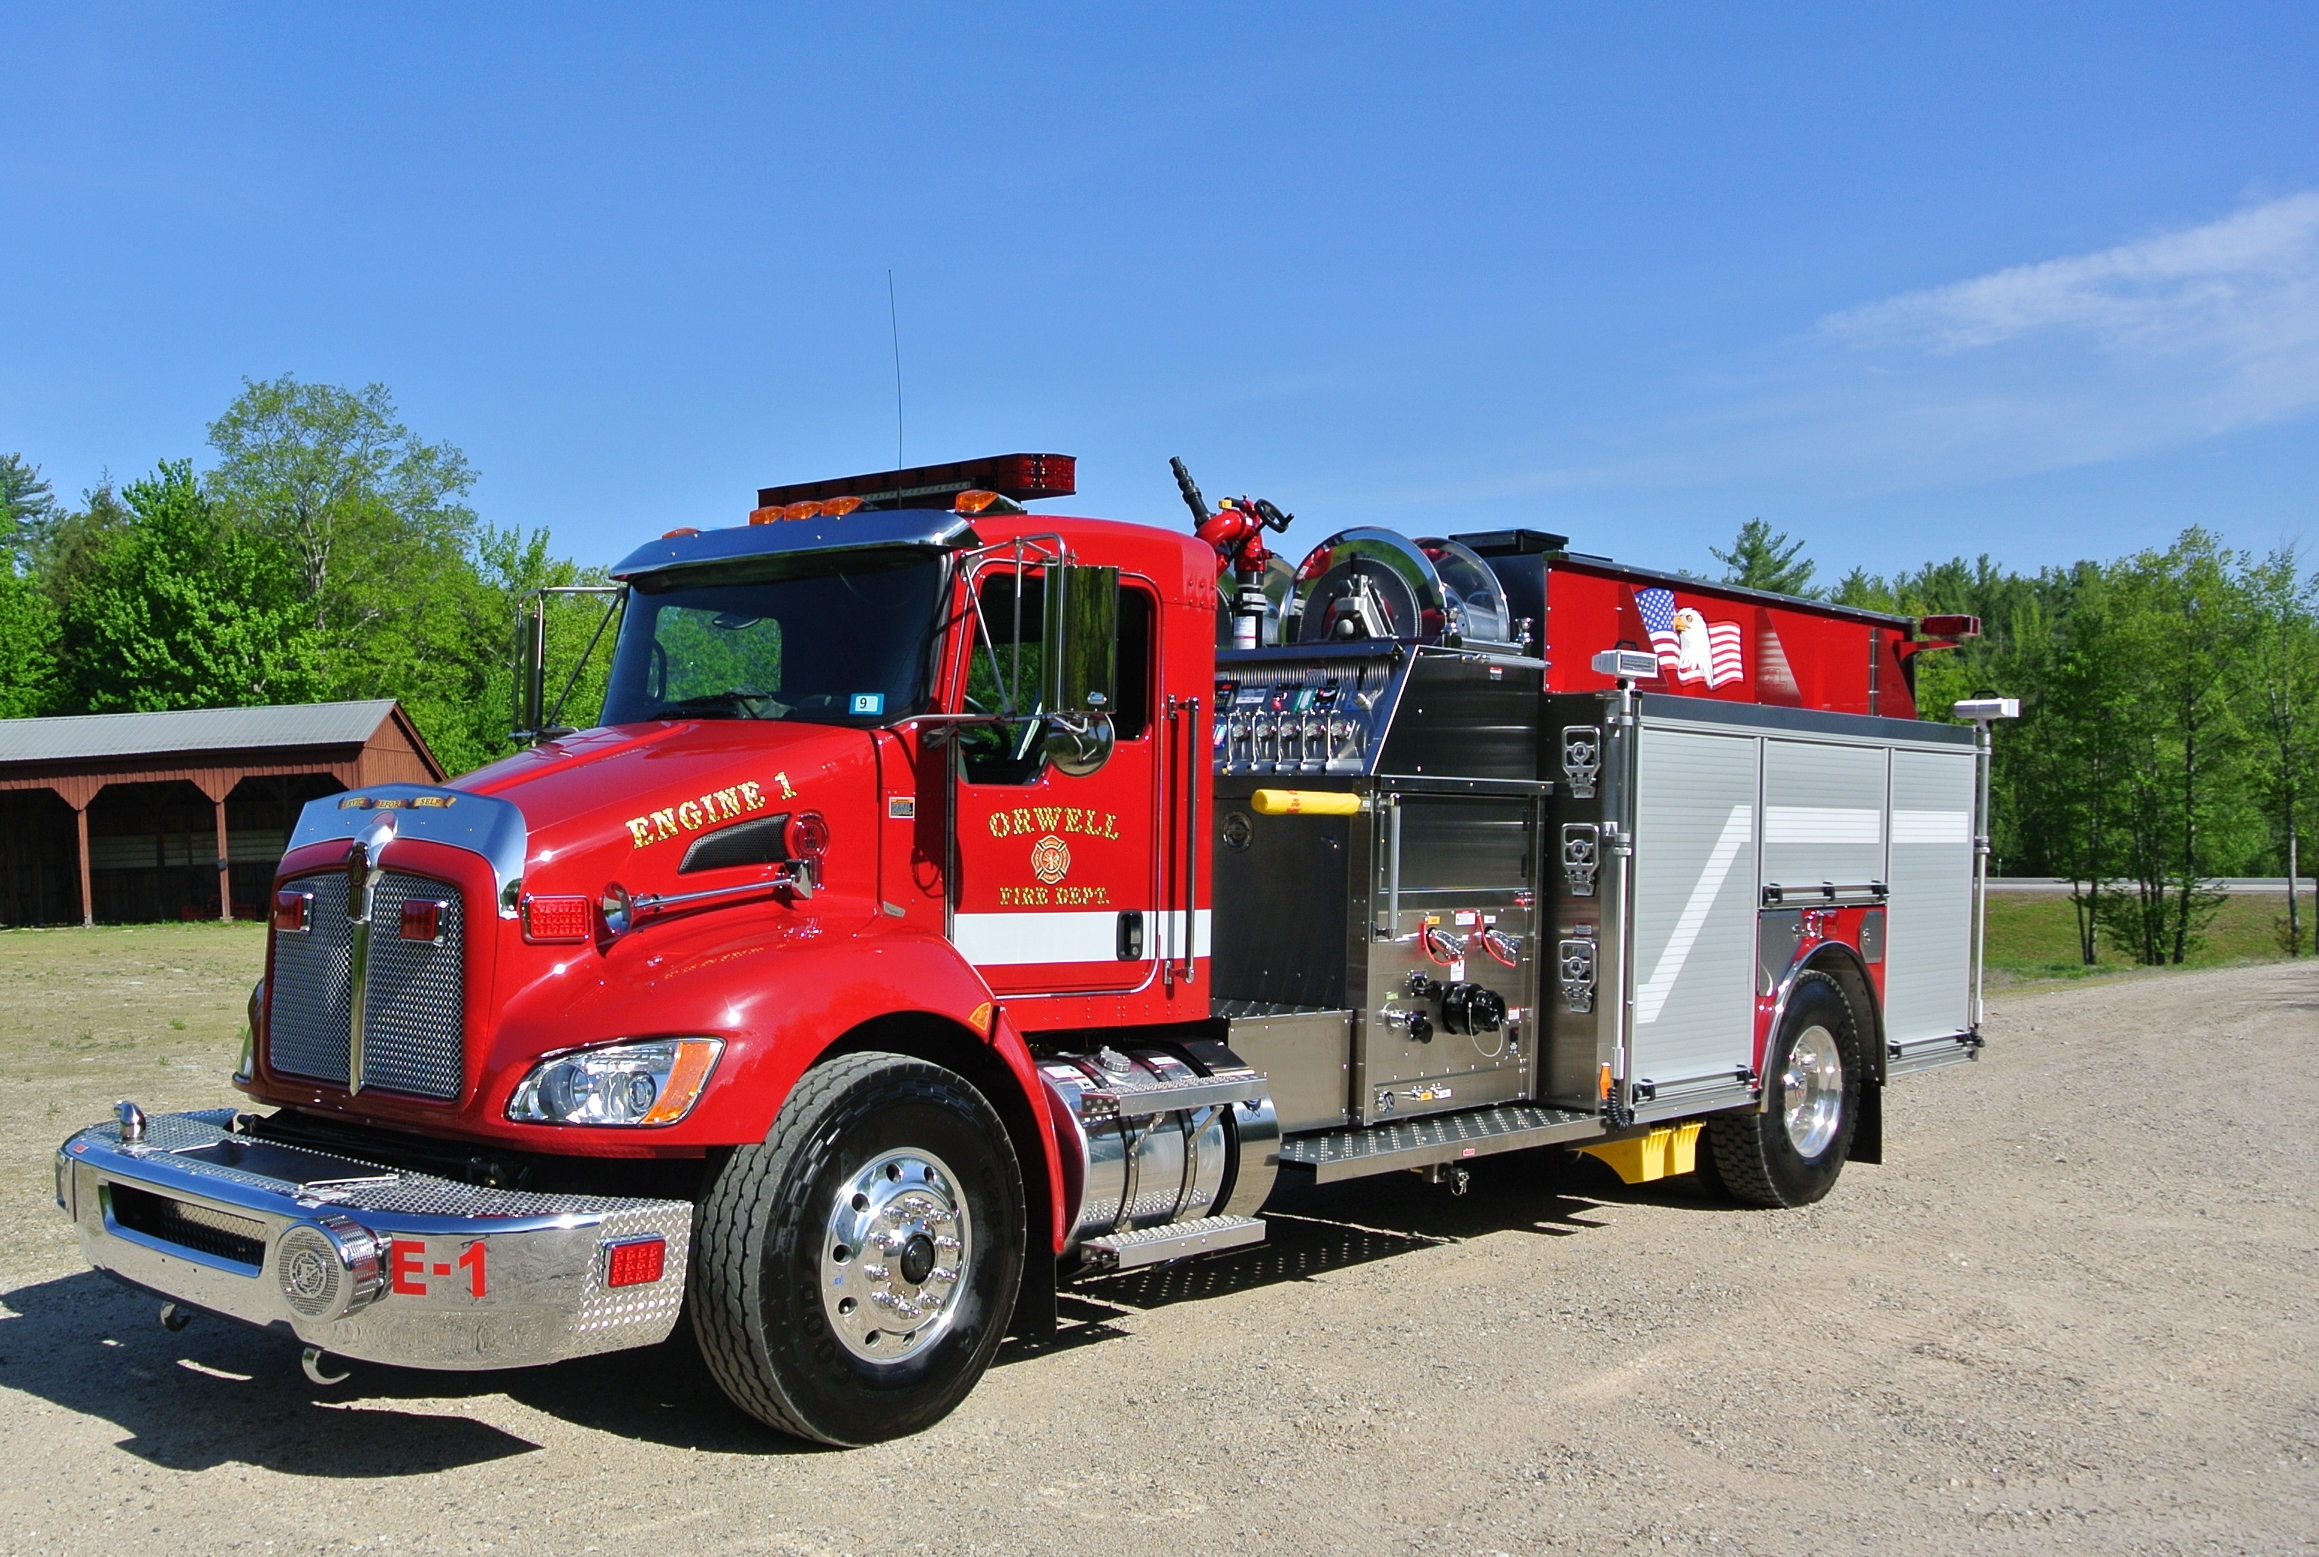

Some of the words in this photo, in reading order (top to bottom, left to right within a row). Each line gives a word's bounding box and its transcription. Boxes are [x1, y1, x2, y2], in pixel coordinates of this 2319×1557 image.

[859, 697, 868, 709] 9
[340, 798, 368, 808] ERVIC
[420, 798, 441, 806] SELF
[624, 780, 766, 849] ENGINE
[774, 771, 798, 800] 1
[988, 806, 1120, 840] ORWELL
[999, 887, 1049, 905] FIRE
[1055, 887, 1110, 905] DEPT.
[391, 1239, 487, 1298] E-1
